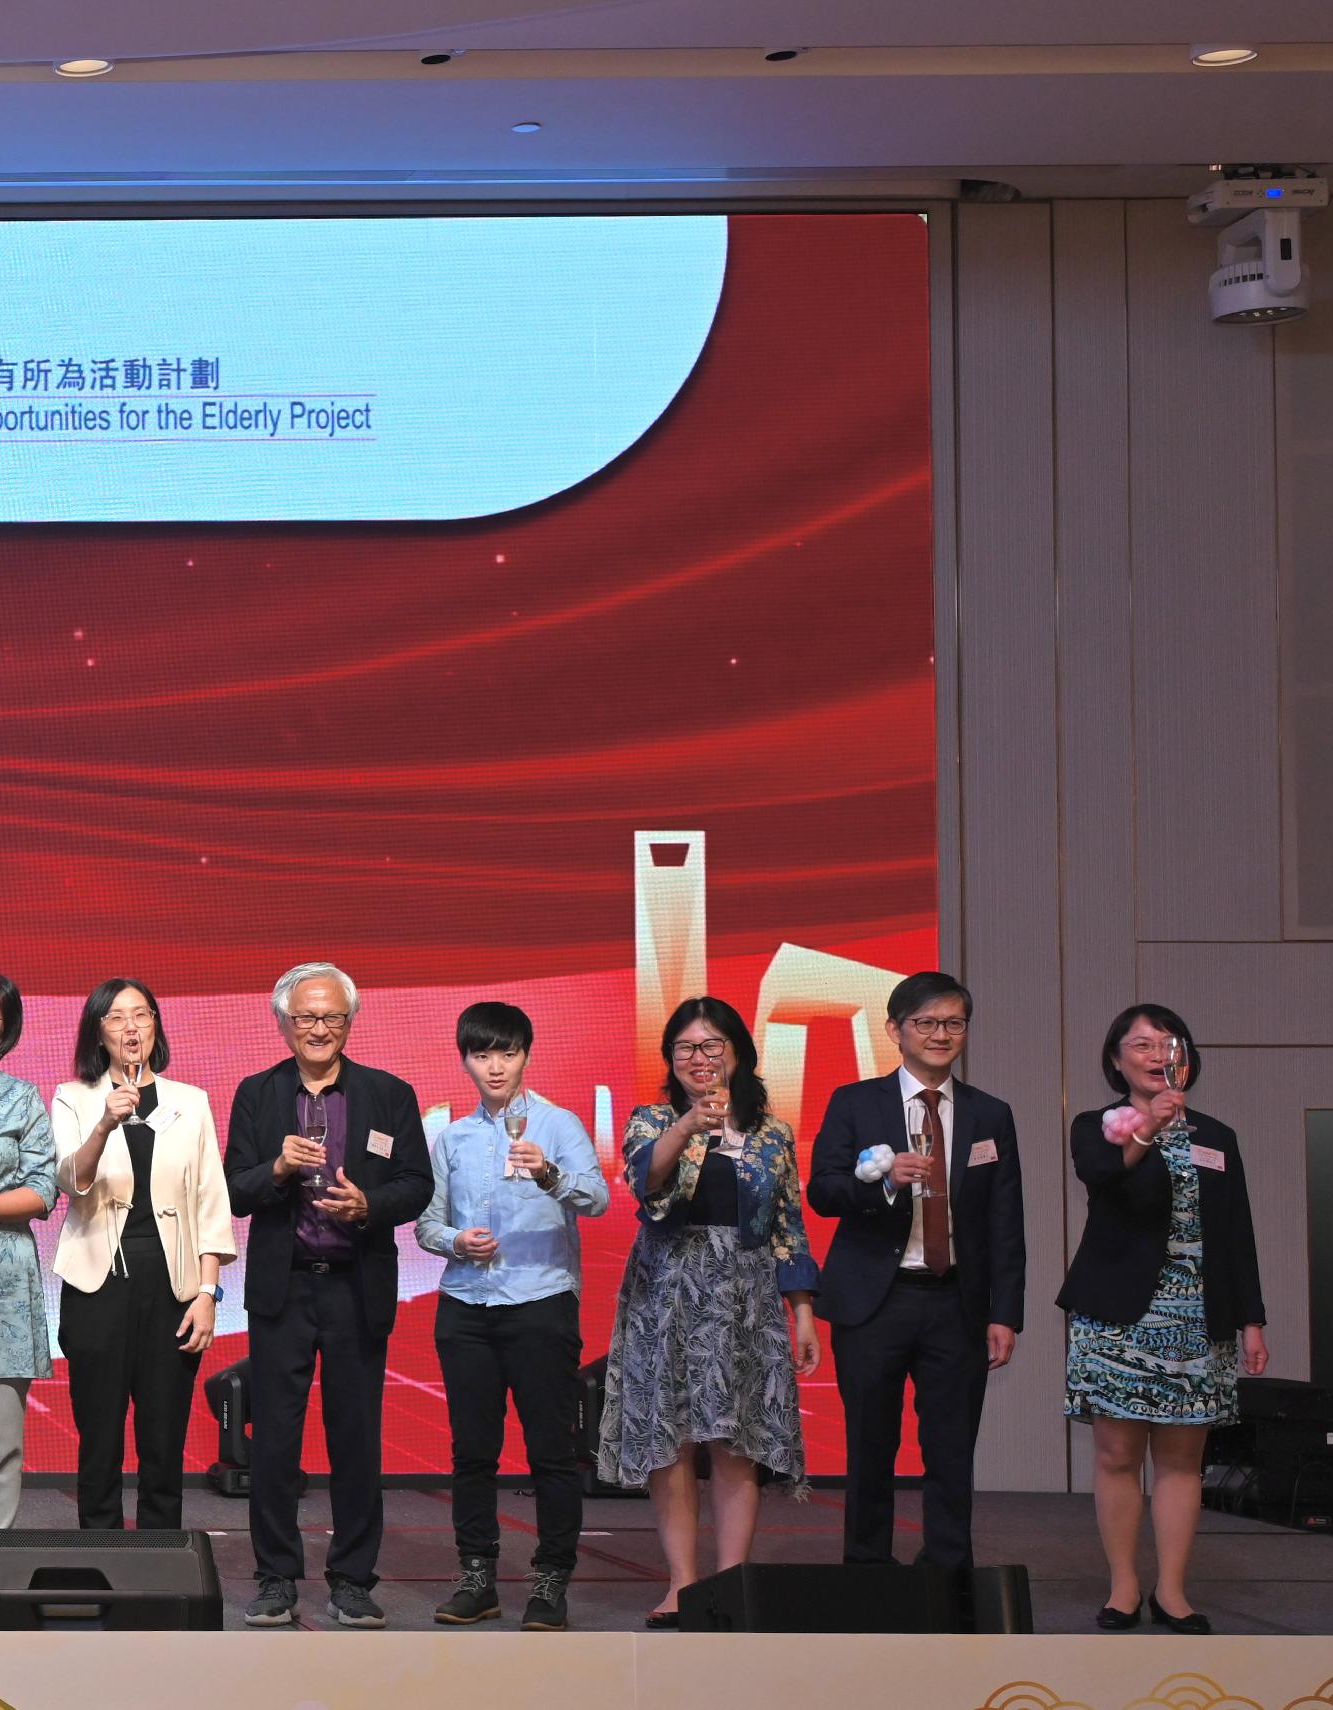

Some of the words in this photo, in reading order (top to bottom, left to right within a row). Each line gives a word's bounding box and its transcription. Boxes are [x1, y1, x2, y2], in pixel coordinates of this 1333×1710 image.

[119, 401, 150, 430] for
[157, 402, 193, 430] the
[202, 402, 281, 437] Elderly
[290, 401, 372, 437] Project
